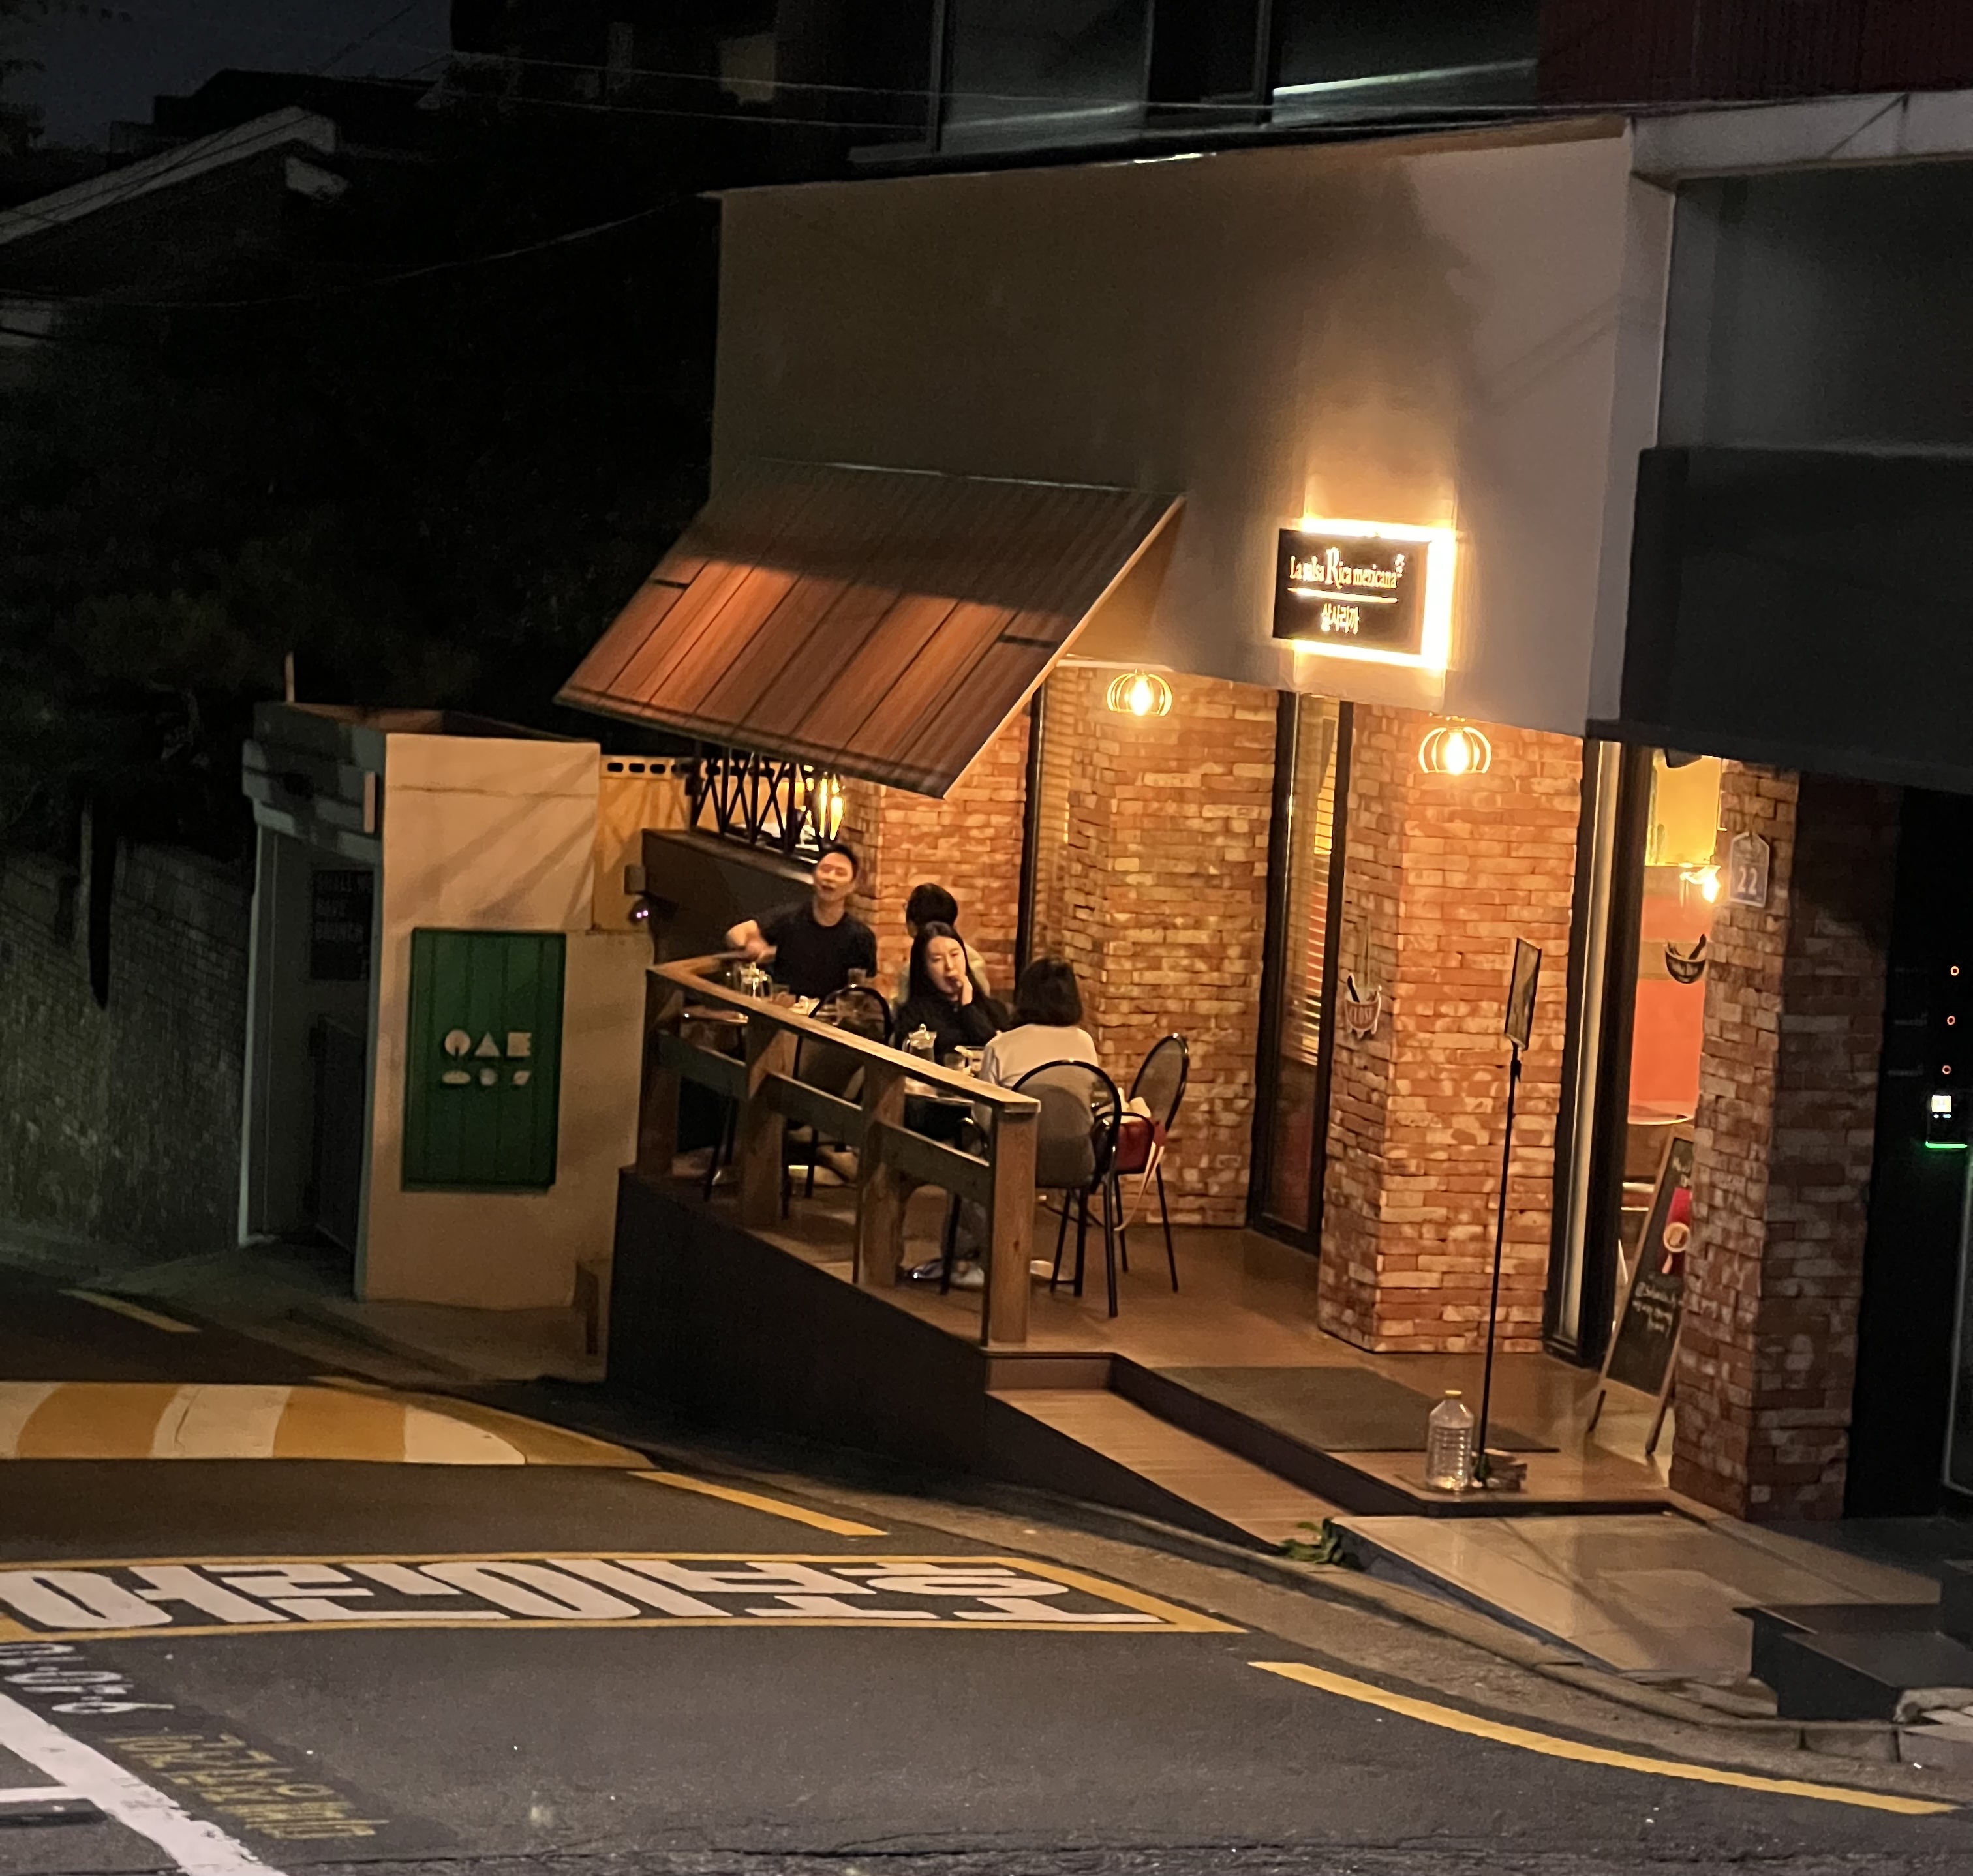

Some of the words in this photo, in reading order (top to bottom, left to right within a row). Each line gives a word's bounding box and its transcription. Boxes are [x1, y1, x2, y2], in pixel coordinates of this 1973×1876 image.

[1289, 556, 1302, 579] La
[1737, 865, 1758, 896] 22
[0, 1560, 1166, 1629] 어린이보호
